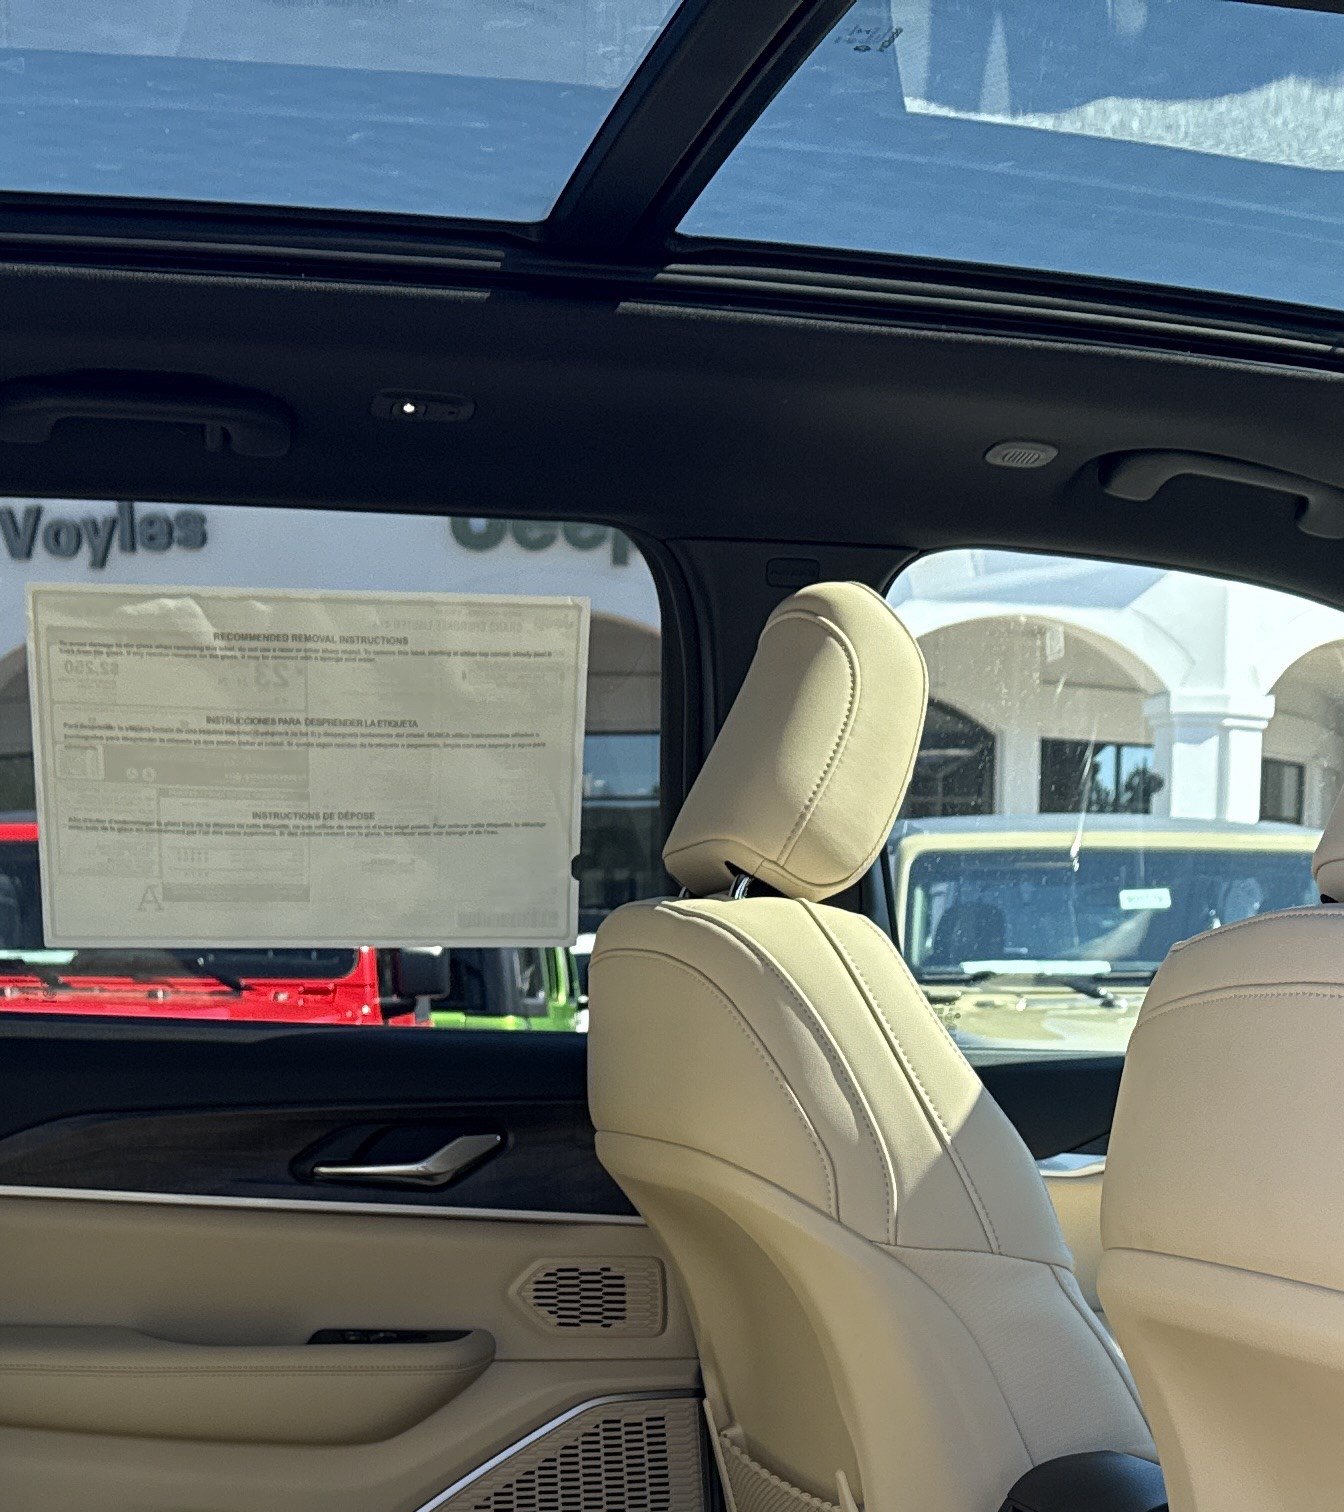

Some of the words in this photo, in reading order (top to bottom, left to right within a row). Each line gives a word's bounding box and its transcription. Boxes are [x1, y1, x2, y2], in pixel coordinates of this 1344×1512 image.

[213, 632, 289, 643] RECOMMENDED
[291, 633, 336, 644] REMOVAL
[338, 635, 410, 646] INSTRUCTIONS
[205, 715, 277, 727] INSTRUCCIONES
[278, 717, 302, 727] PARA
[304, 718, 364, 728] DESPRENDER
[364, 719, 376, 728] LA
[376, 719, 420, 729] ETIQUETA
[252, 811, 321, 821] INSTRUCTIONS
[322, 811, 336, 821] DE
[337, 810, 376, 822] DÉPOSE
